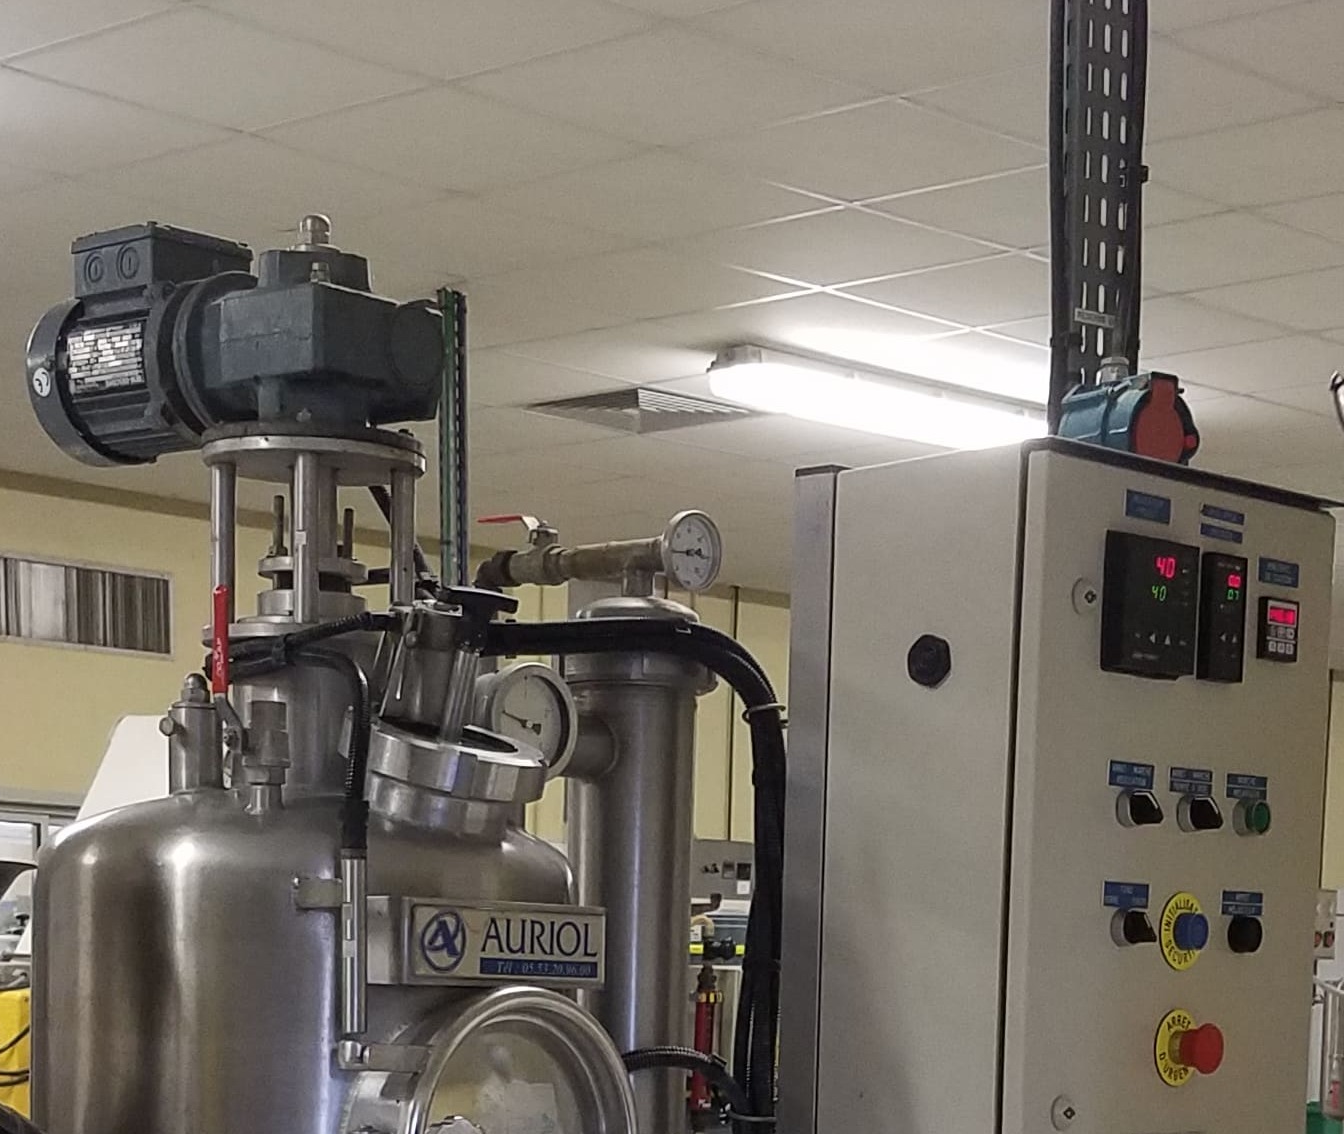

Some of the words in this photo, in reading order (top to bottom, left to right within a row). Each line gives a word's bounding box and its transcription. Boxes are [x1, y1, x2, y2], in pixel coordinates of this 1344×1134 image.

[1155, 556, 1176, 579] 40
[1152, 585, 1167, 601] 40
[480, 917, 598, 957] AURIOL
[1159, 1052, 1189, 1081] D'URGEN
